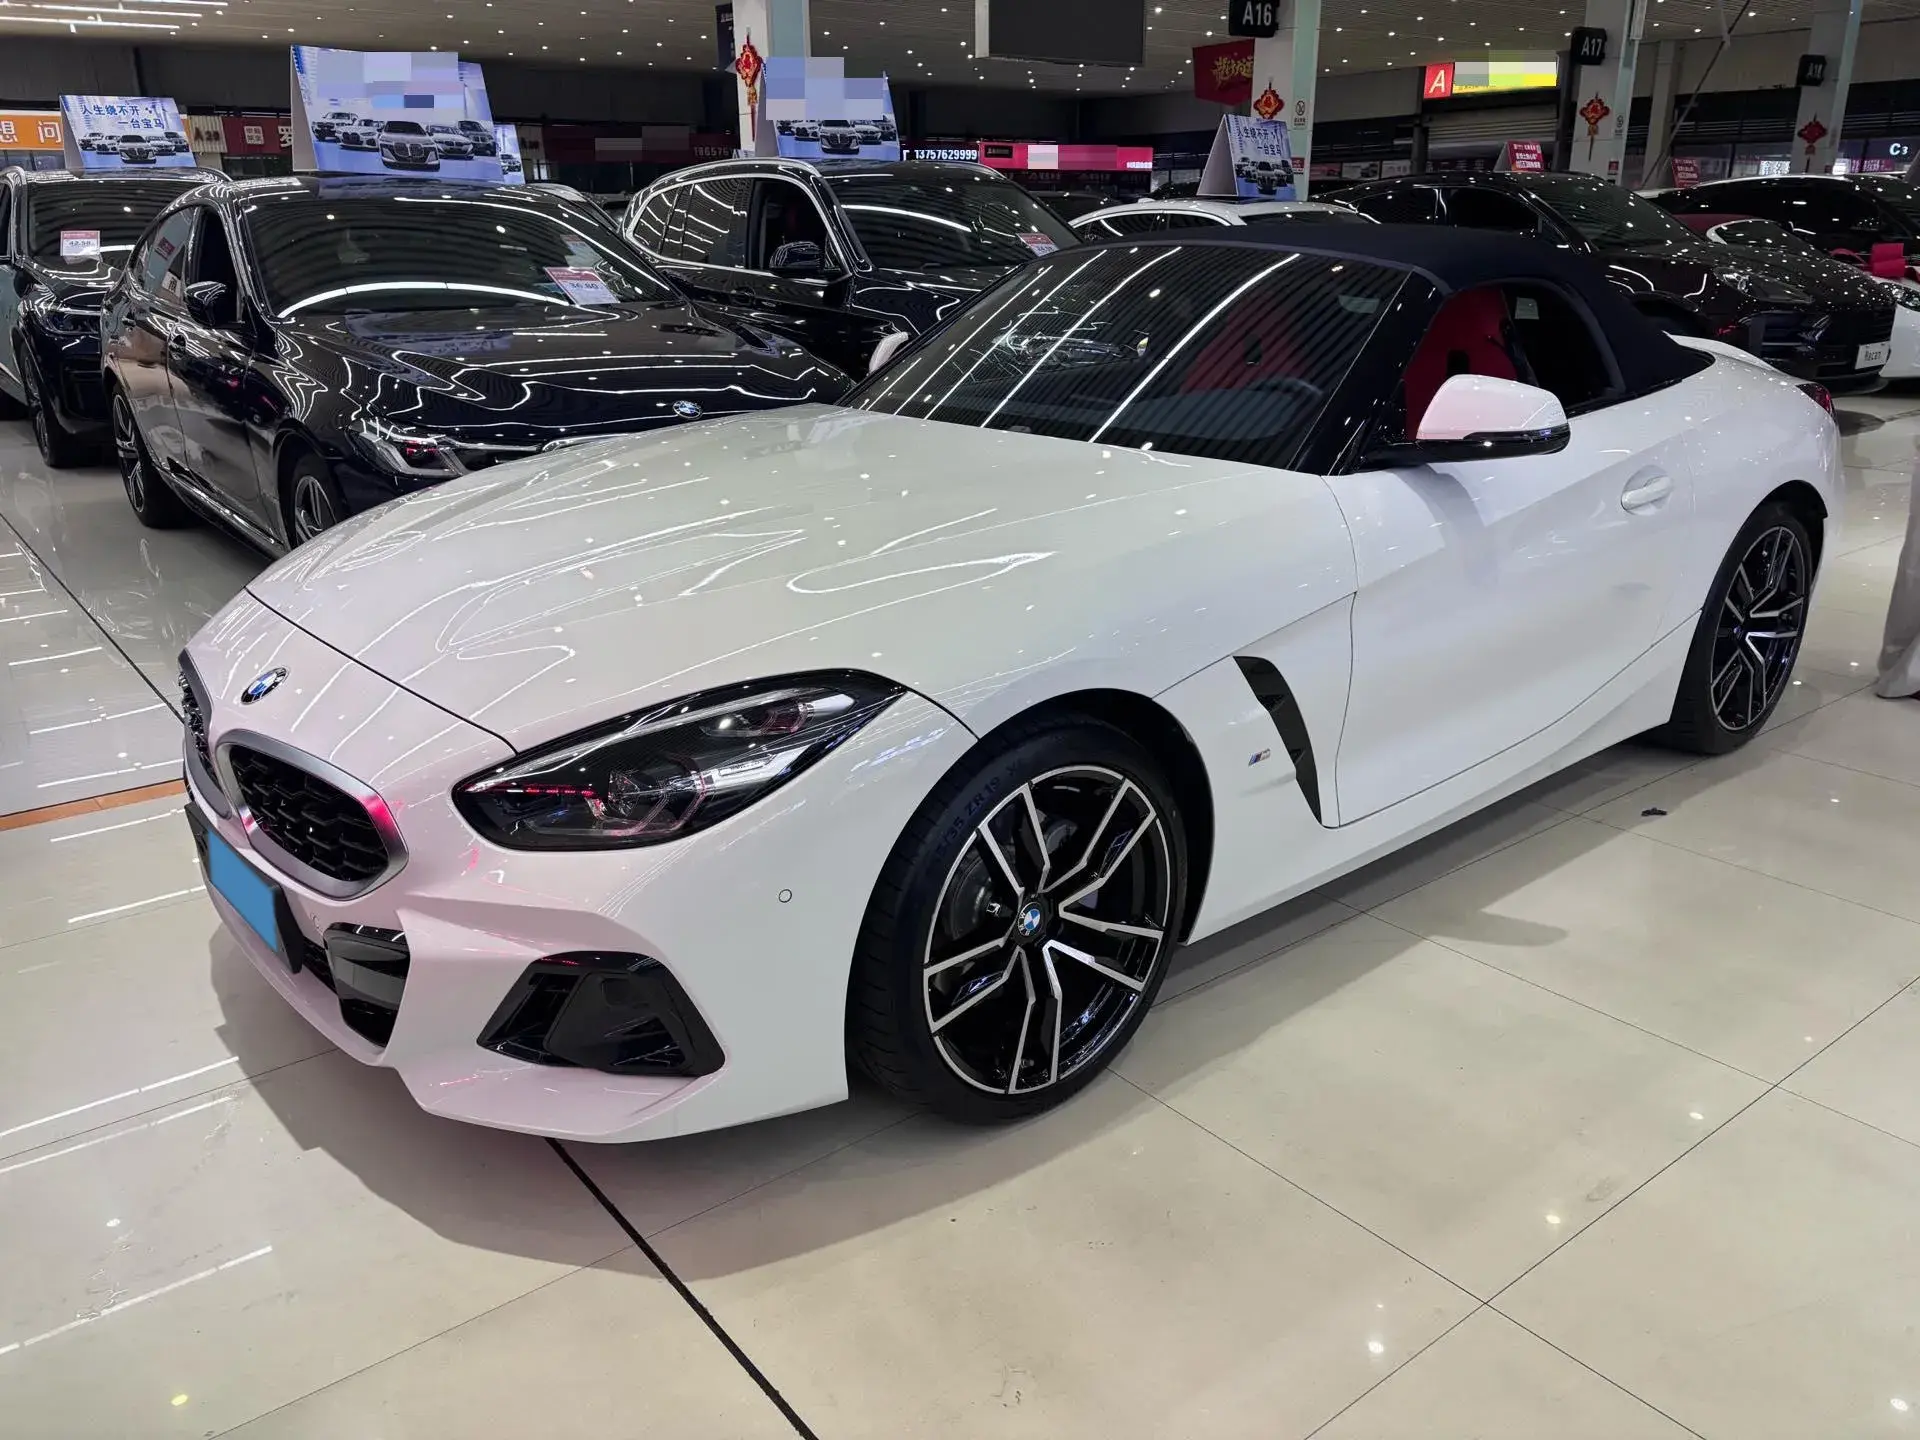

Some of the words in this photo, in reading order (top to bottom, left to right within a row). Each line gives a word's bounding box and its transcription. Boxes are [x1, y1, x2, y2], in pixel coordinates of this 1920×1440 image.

[1242, 1, 1272, 26] A16
[1581, 35, 1603, 56] A17
[1429, 69, 1446, 93] A
[118, 118, 165, 129] 一台宝马
[914, 149, 977, 160] 13757629999
